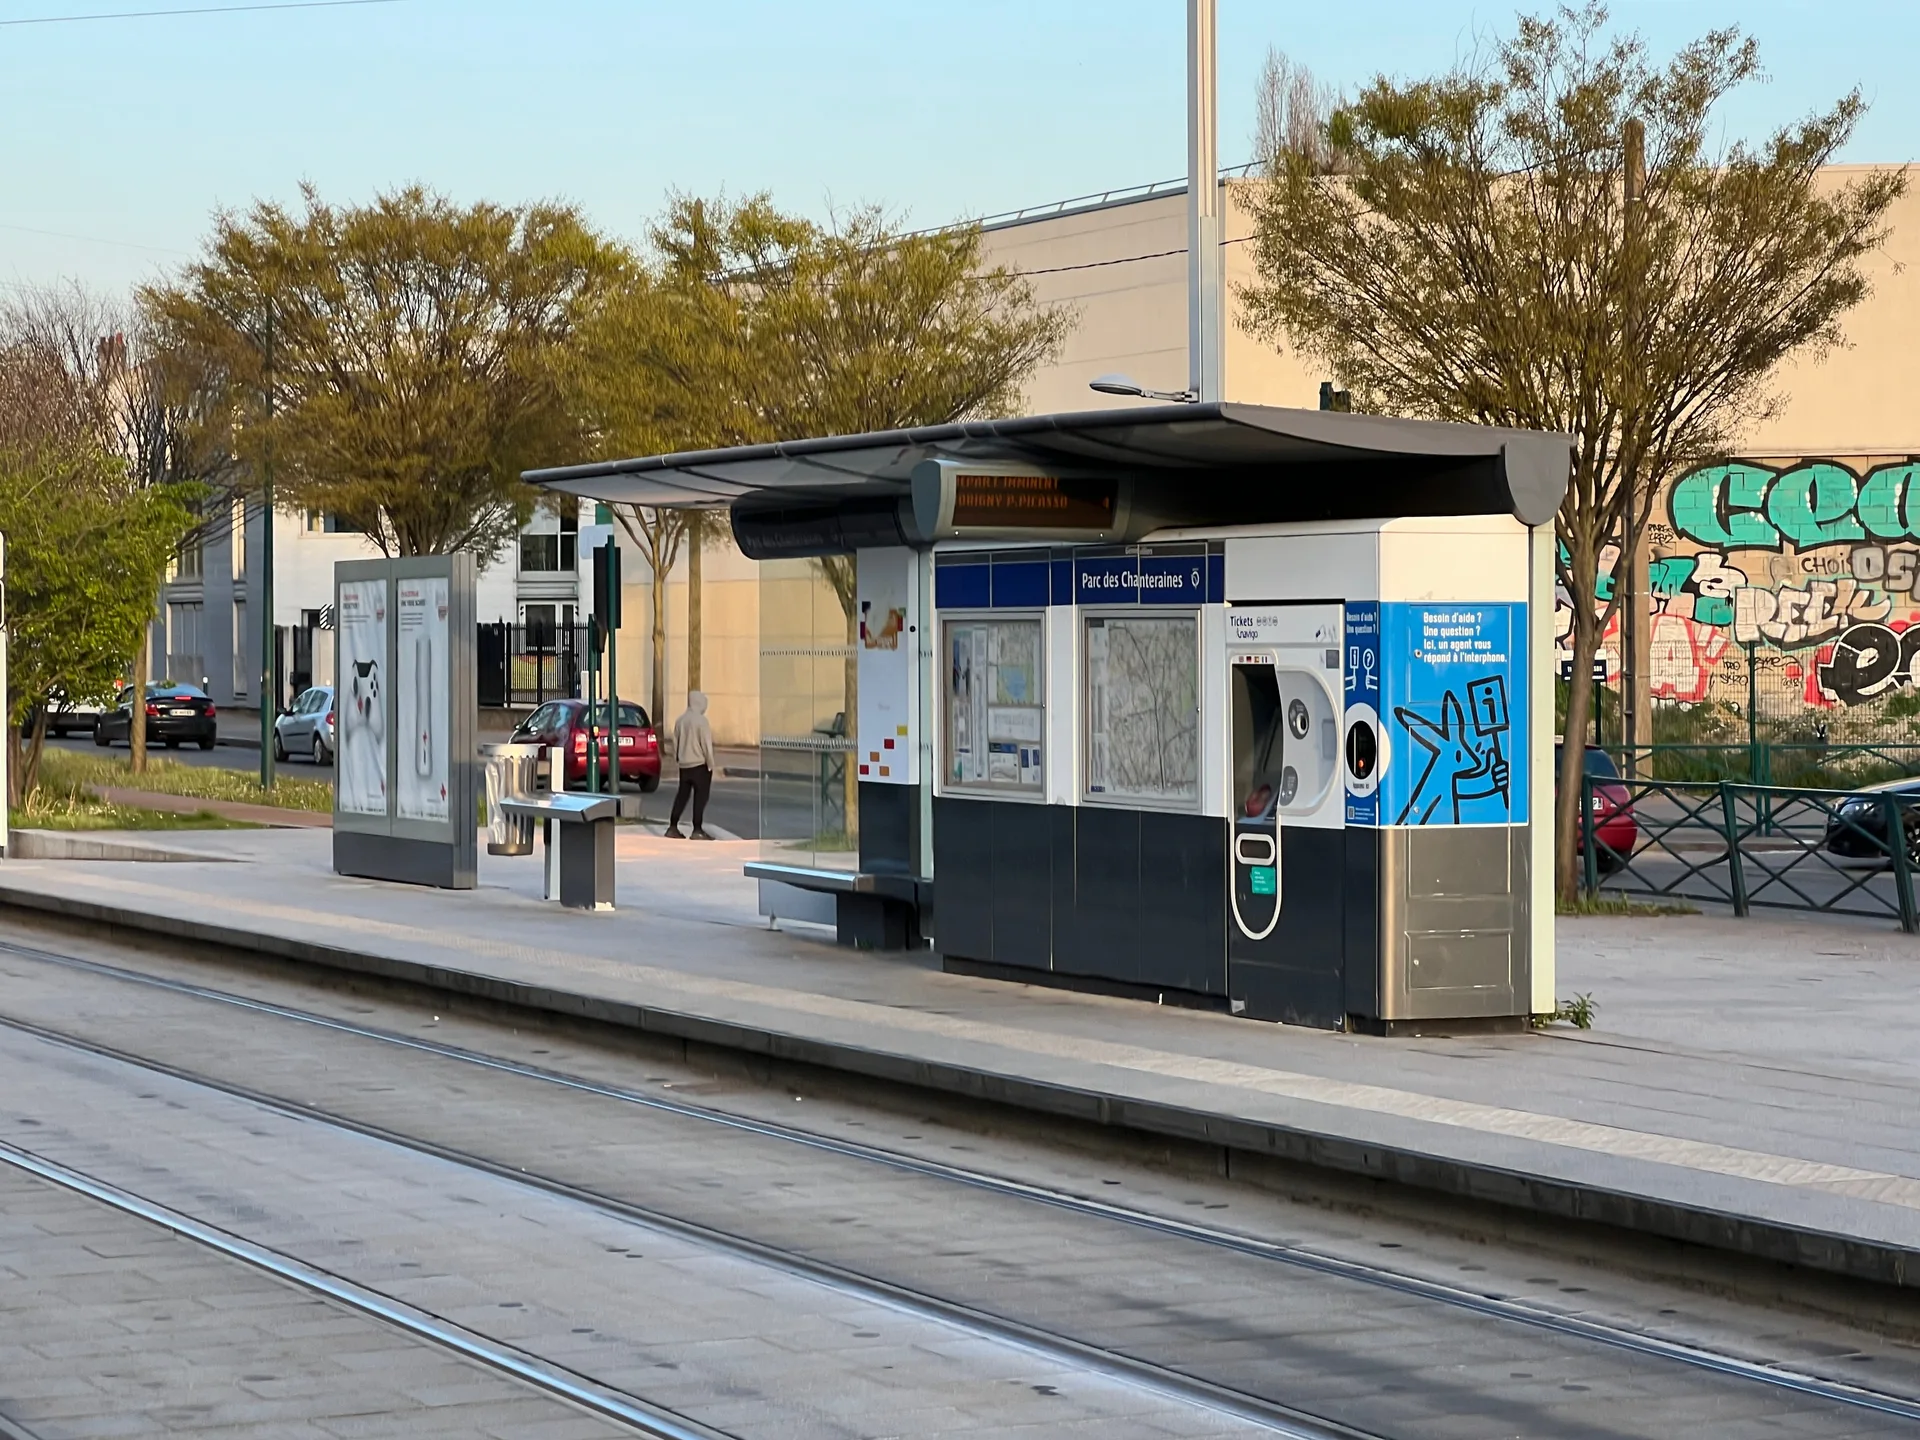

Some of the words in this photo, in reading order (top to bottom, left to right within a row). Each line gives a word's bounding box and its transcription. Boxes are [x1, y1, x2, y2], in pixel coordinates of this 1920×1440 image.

[957, 476, 999, 488] EPART
[1082, 572, 1101, 589] Parc
[1103, 571, 1119, 588] des
[1121, 571, 1183, 589] Chanteraines
[1230, 616, 1253, 627] Tickets
[1423, 612, 1450, 623] Besoin
[1451, 612, 1475, 623] d'aide
[1477, 612, 1482, 623] ?
[1423, 625, 1438, 636] Une
[1440, 625, 1474, 639] question
[1476, 625, 1481, 636] ?
[1423, 638, 1436, 650] Ici,
[1438, 640, 1448, 650] un
[1450, 638, 1472, 652] agent
[1474, 640, 1492, 650] vous
[1423, 651, 1451, 665] répond
[1453, 652, 1458, 663] à
